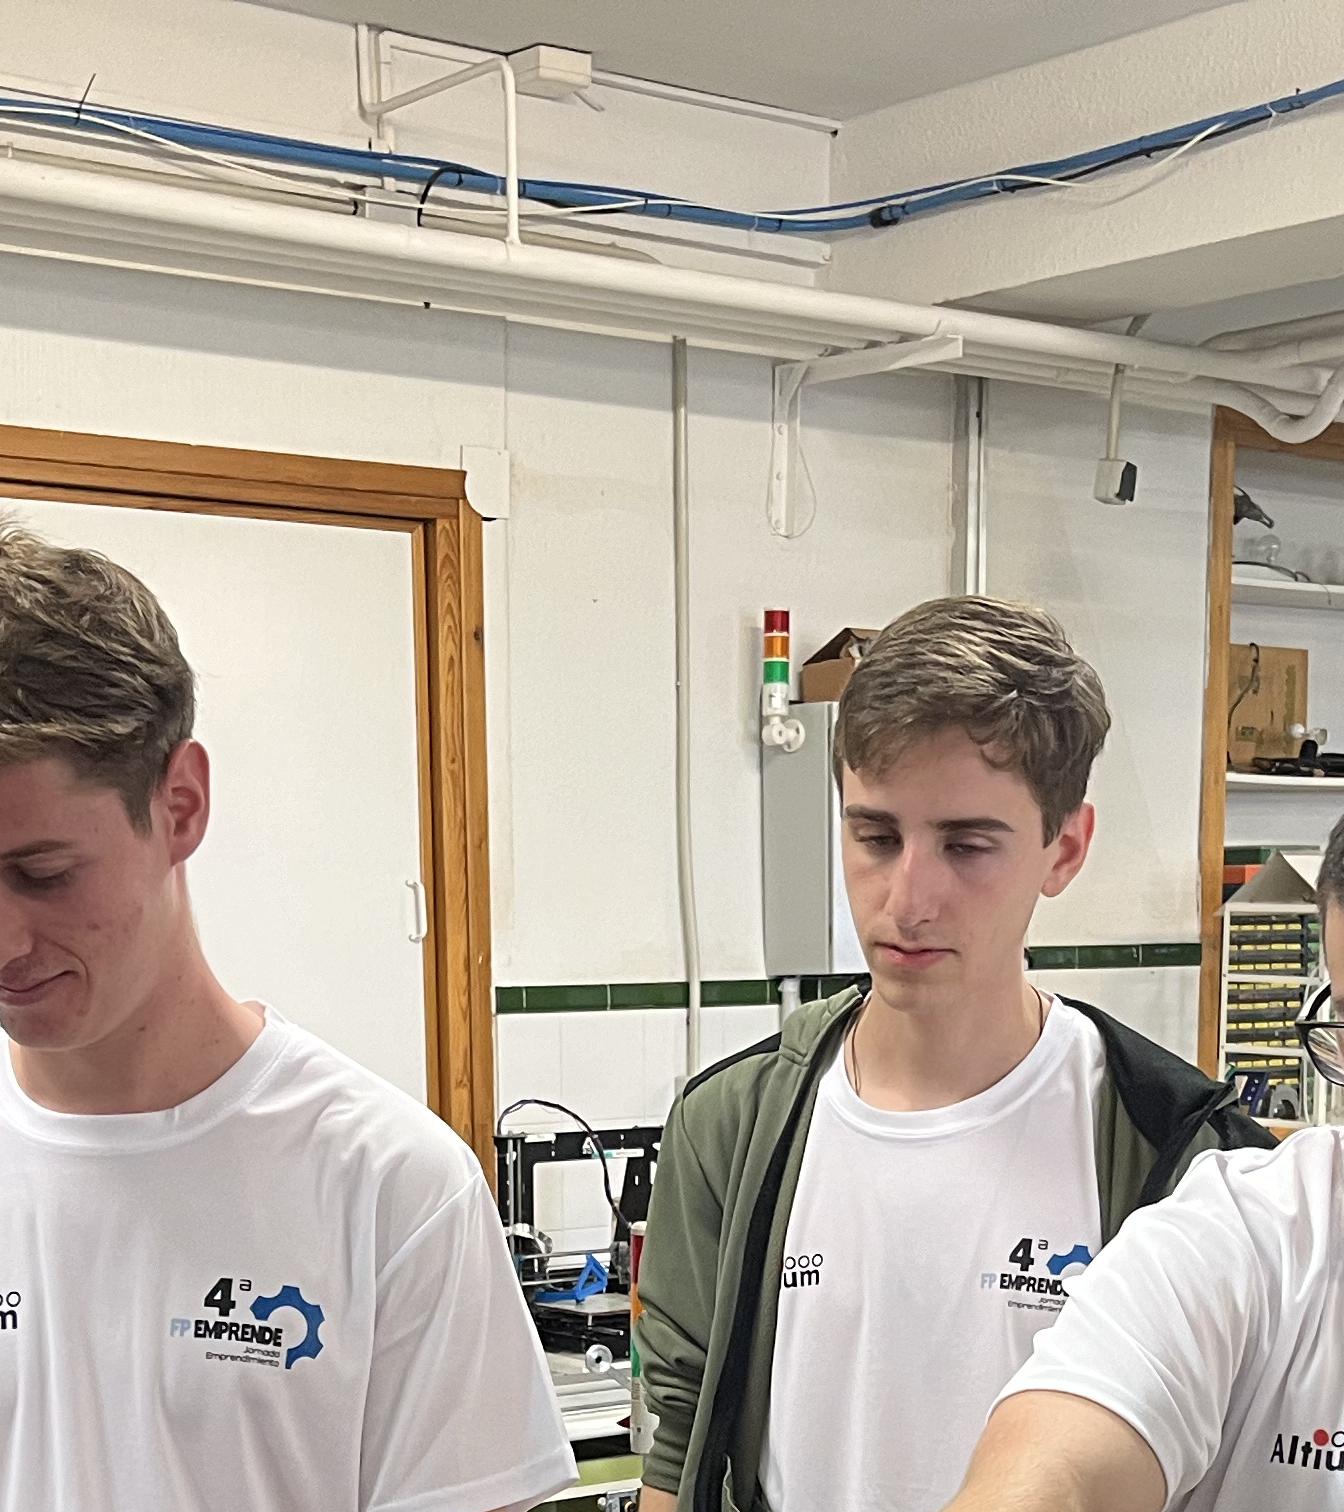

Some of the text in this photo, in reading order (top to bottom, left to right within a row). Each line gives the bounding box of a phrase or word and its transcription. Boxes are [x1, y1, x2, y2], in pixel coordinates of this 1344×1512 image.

[980, 1272, 1069, 1298] FP EMPREND
[170, 1318, 284, 1348] FP EMPRENDE
[206, 1351, 280, 1368] Emprendimiento
[243, 1345, 281, 1358] Jornada
